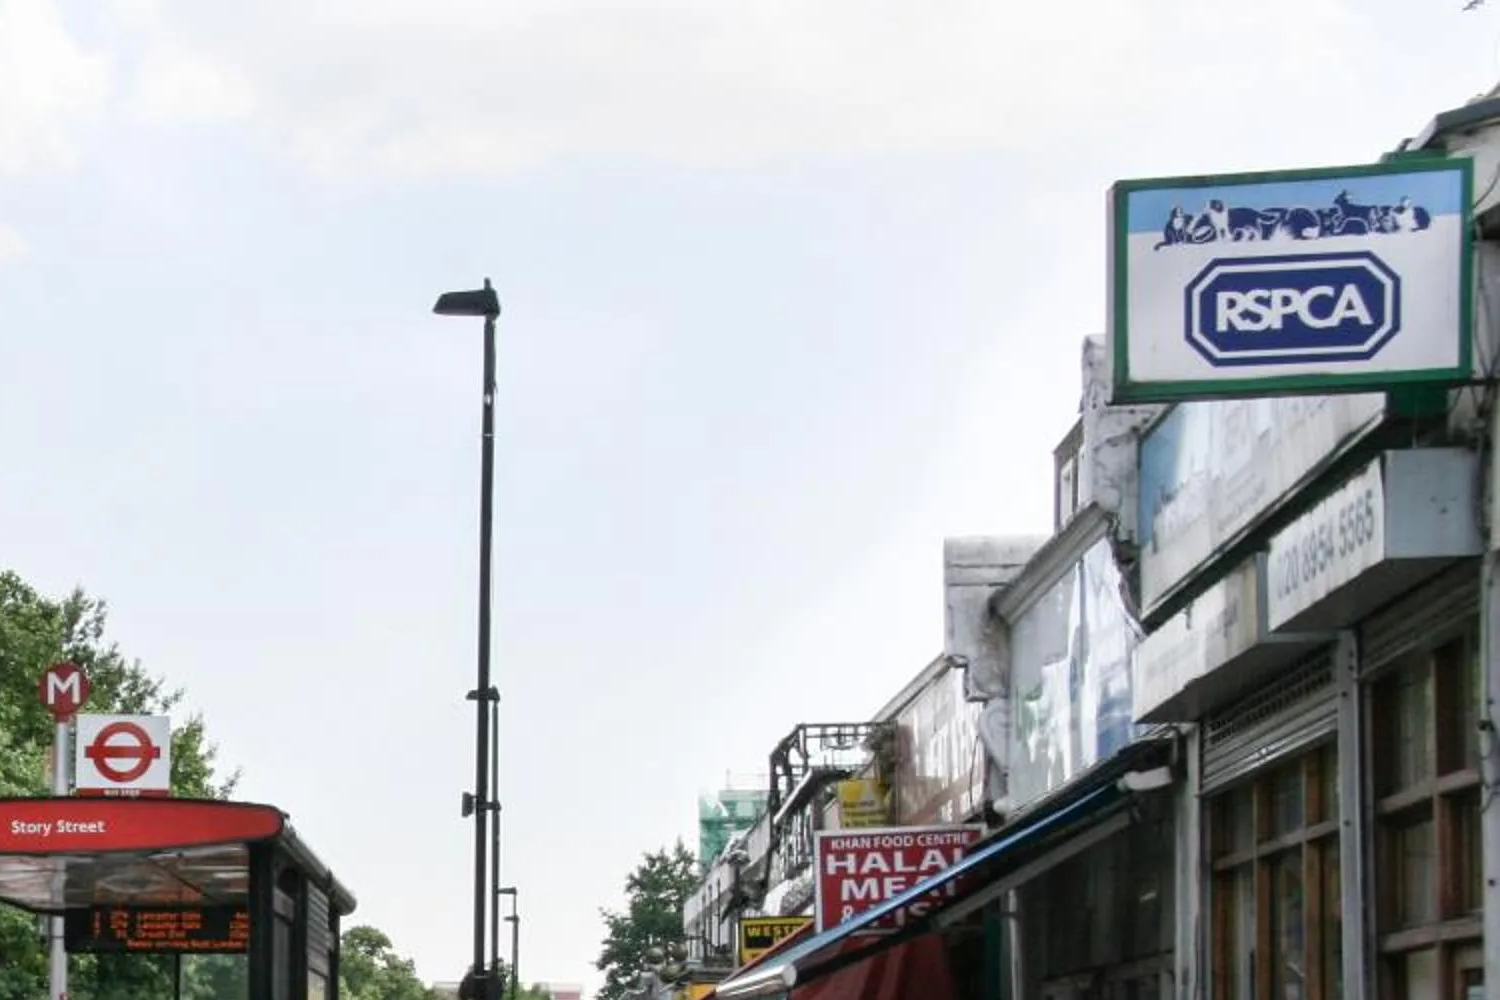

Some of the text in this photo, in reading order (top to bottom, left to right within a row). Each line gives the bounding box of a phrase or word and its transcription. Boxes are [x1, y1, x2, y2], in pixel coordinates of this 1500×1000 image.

[1216, 284, 1373, 332] RSPCA
[47, 672, 81, 705] M
[11, 821, 106, 837] Story Street
[831, 833, 971, 850] KHAN FOOD CENTRE
